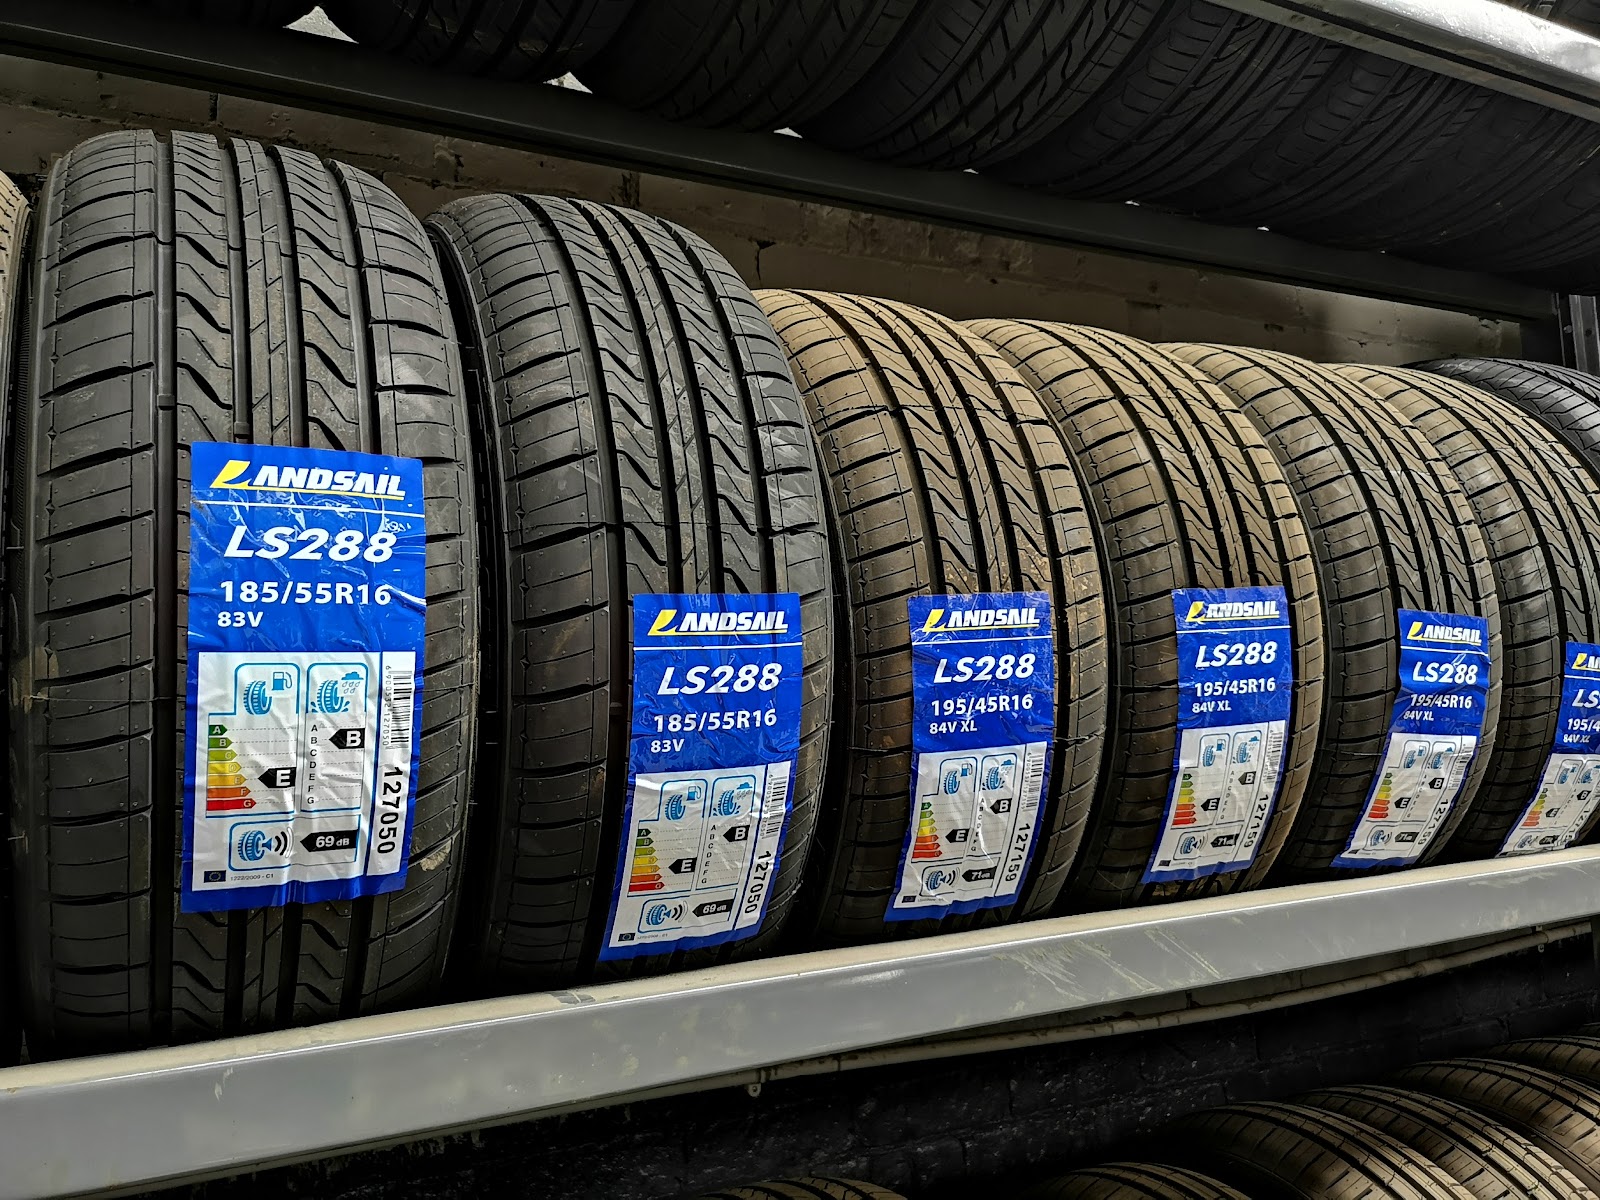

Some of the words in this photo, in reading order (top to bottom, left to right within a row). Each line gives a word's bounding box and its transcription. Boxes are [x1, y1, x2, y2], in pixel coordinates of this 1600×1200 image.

[210, 460, 406, 499] LANDSAIL
[223, 525, 397, 563] LS288
[220, 581, 392, 605] 185/55R16
[217, 611, 264, 627] 83V
[922, 608, 1040, 632] LANDSAIL
[1185, 601, 1280, 622] LANDSAIL
[647, 609, 788, 636] LANDSAIL
[1407, 621, 1482, 646] LANDSAIL
[1195, 641, 1278, 668] LS288
[933, 653, 1036, 684] LS288
[1412, 661, 1478, 685] LS288
[657, 663, 783, 695] LS288
[1195, 677, 1276, 697] 195/45R16
[931, 694, 1033, 717] 195/45R16
[1192, 702, 1215, 713] 84V
[1217, 700, 1232, 711] XL
[1410, 694, 1472, 709] 195/45R16
[654, 709, 777, 733] 185/55R16
[1403, 711, 1423, 720] 84V
[1423, 711, 1434, 721] XL
[213, 726, 221, 734] A
[929, 722, 957, 734] 84V
[960, 720, 977, 732] XL
[346, 730, 361, 747] B
[650, 739, 685, 753] 83V
[1563, 733, 1580, 743] 84V
[276, 769, 291, 787] E
[1246, 773, 1255, 784] B
[1433, 779, 1442, 788] B
[243, 800, 251, 808] G
[377, 767, 403, 854] 127050
[999, 800, 1009, 812] B
[1208, 799, 1218, 809] E
[1400, 798, 1409, 808] E
[1244, 794, 1269, 848] 127159
[315, 836, 335, 848] 69
[336, 838, 350, 846] dB
[734, 828, 746, 840] B
[955, 830, 966, 841] E
[1005, 823, 1031, 881] 127159
[680, 859, 693, 872] E
[744, 851, 772, 914] 127050
[702, 904, 716, 914] 69
